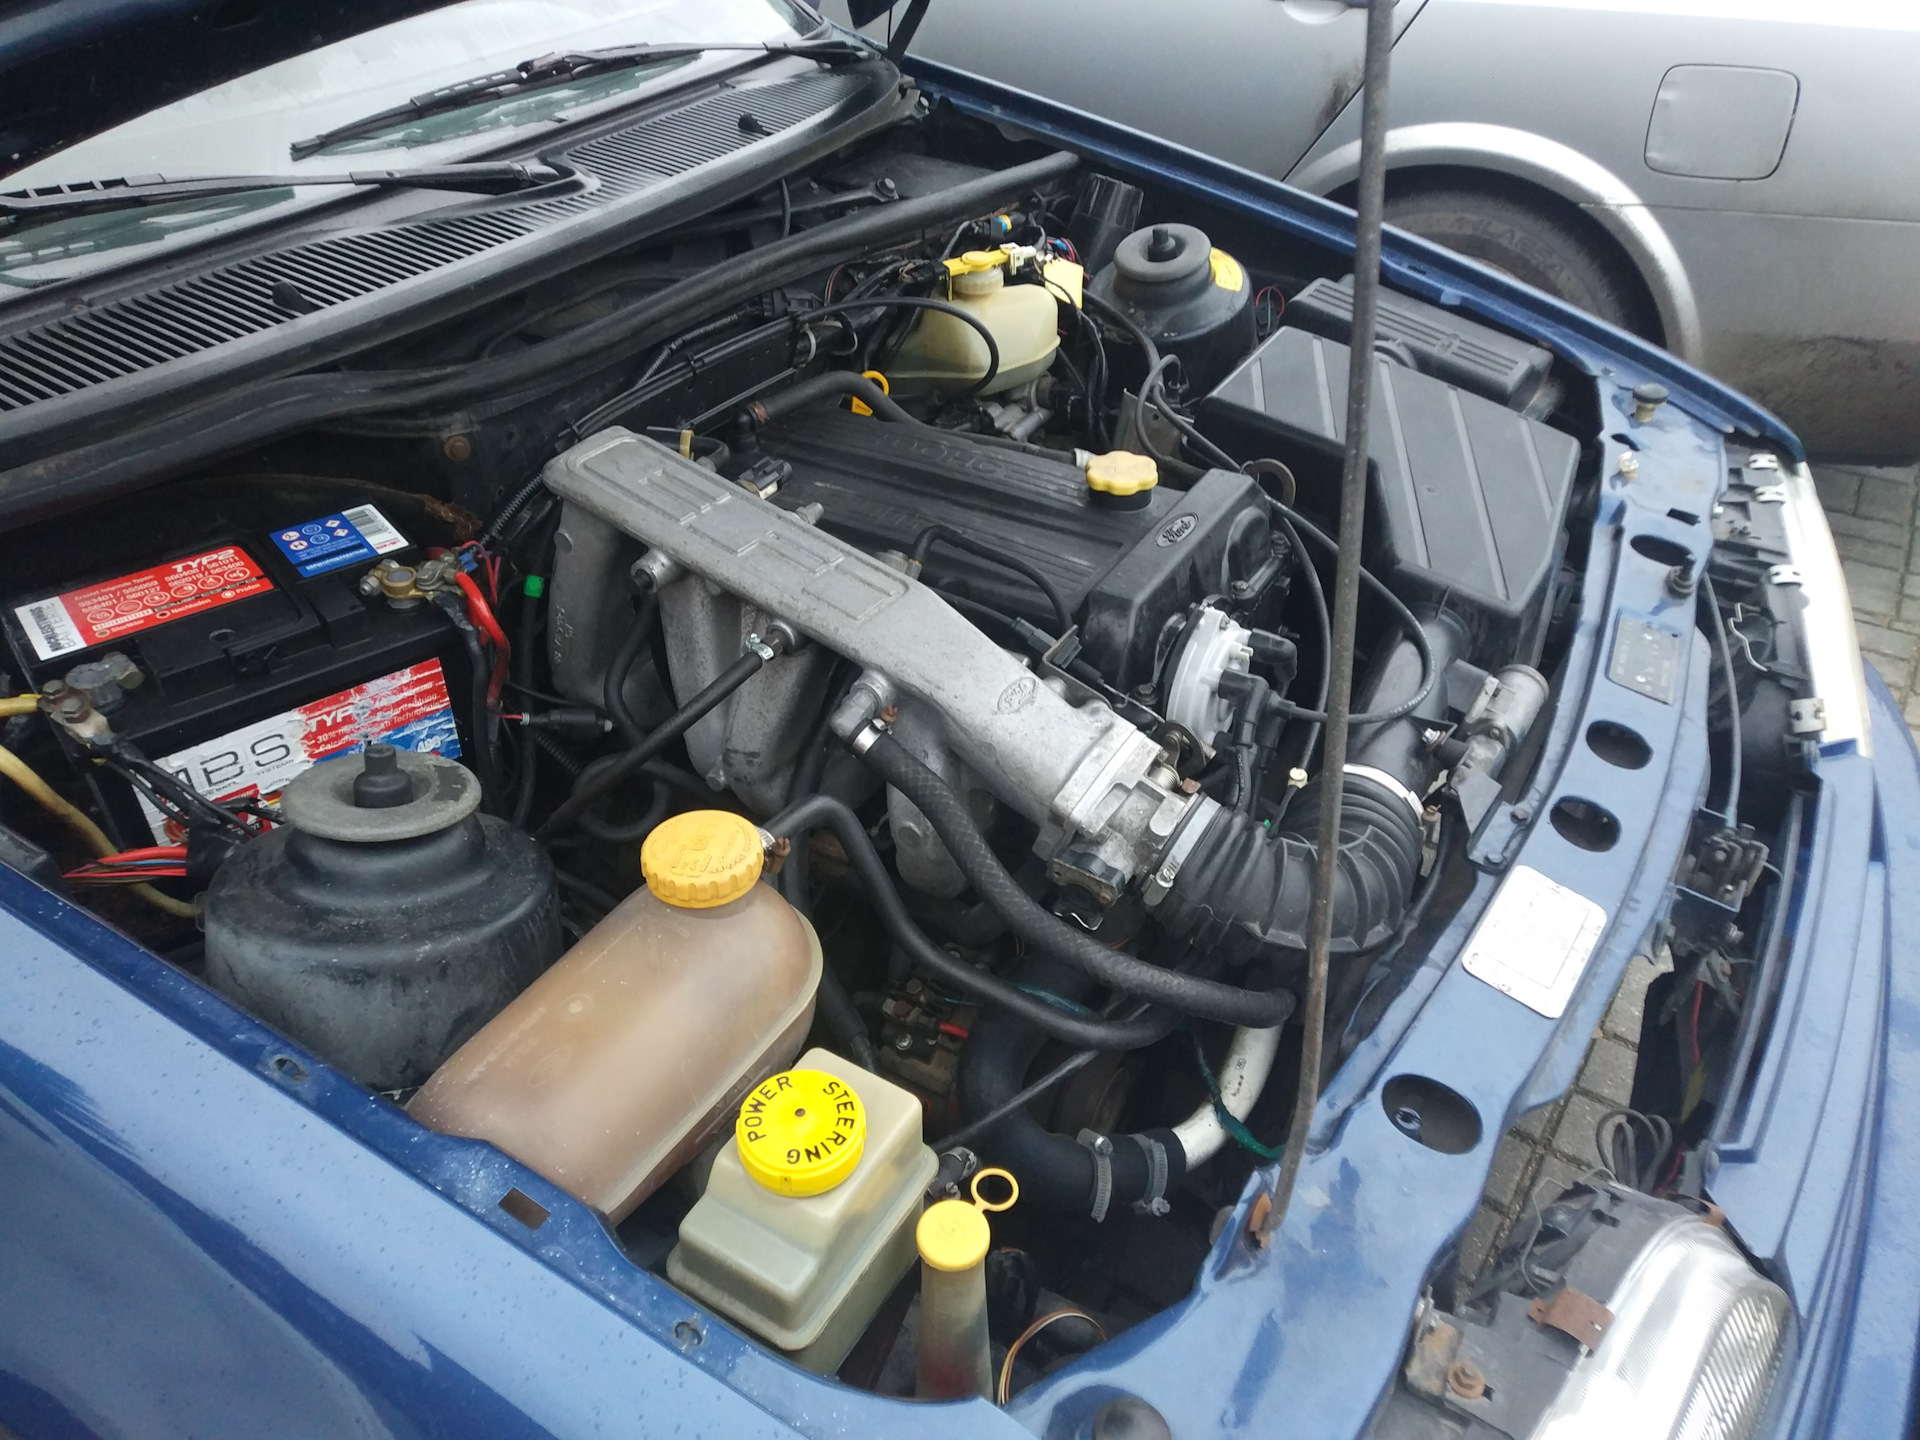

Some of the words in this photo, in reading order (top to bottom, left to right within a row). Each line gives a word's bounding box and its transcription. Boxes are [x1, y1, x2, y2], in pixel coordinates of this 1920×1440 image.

[1159, 517, 1194, 545] Ford
[170, 549, 238, 573] TYP2
[745, 1076, 793, 1143] POWER
[786, 1081, 855, 1165] STEERING
